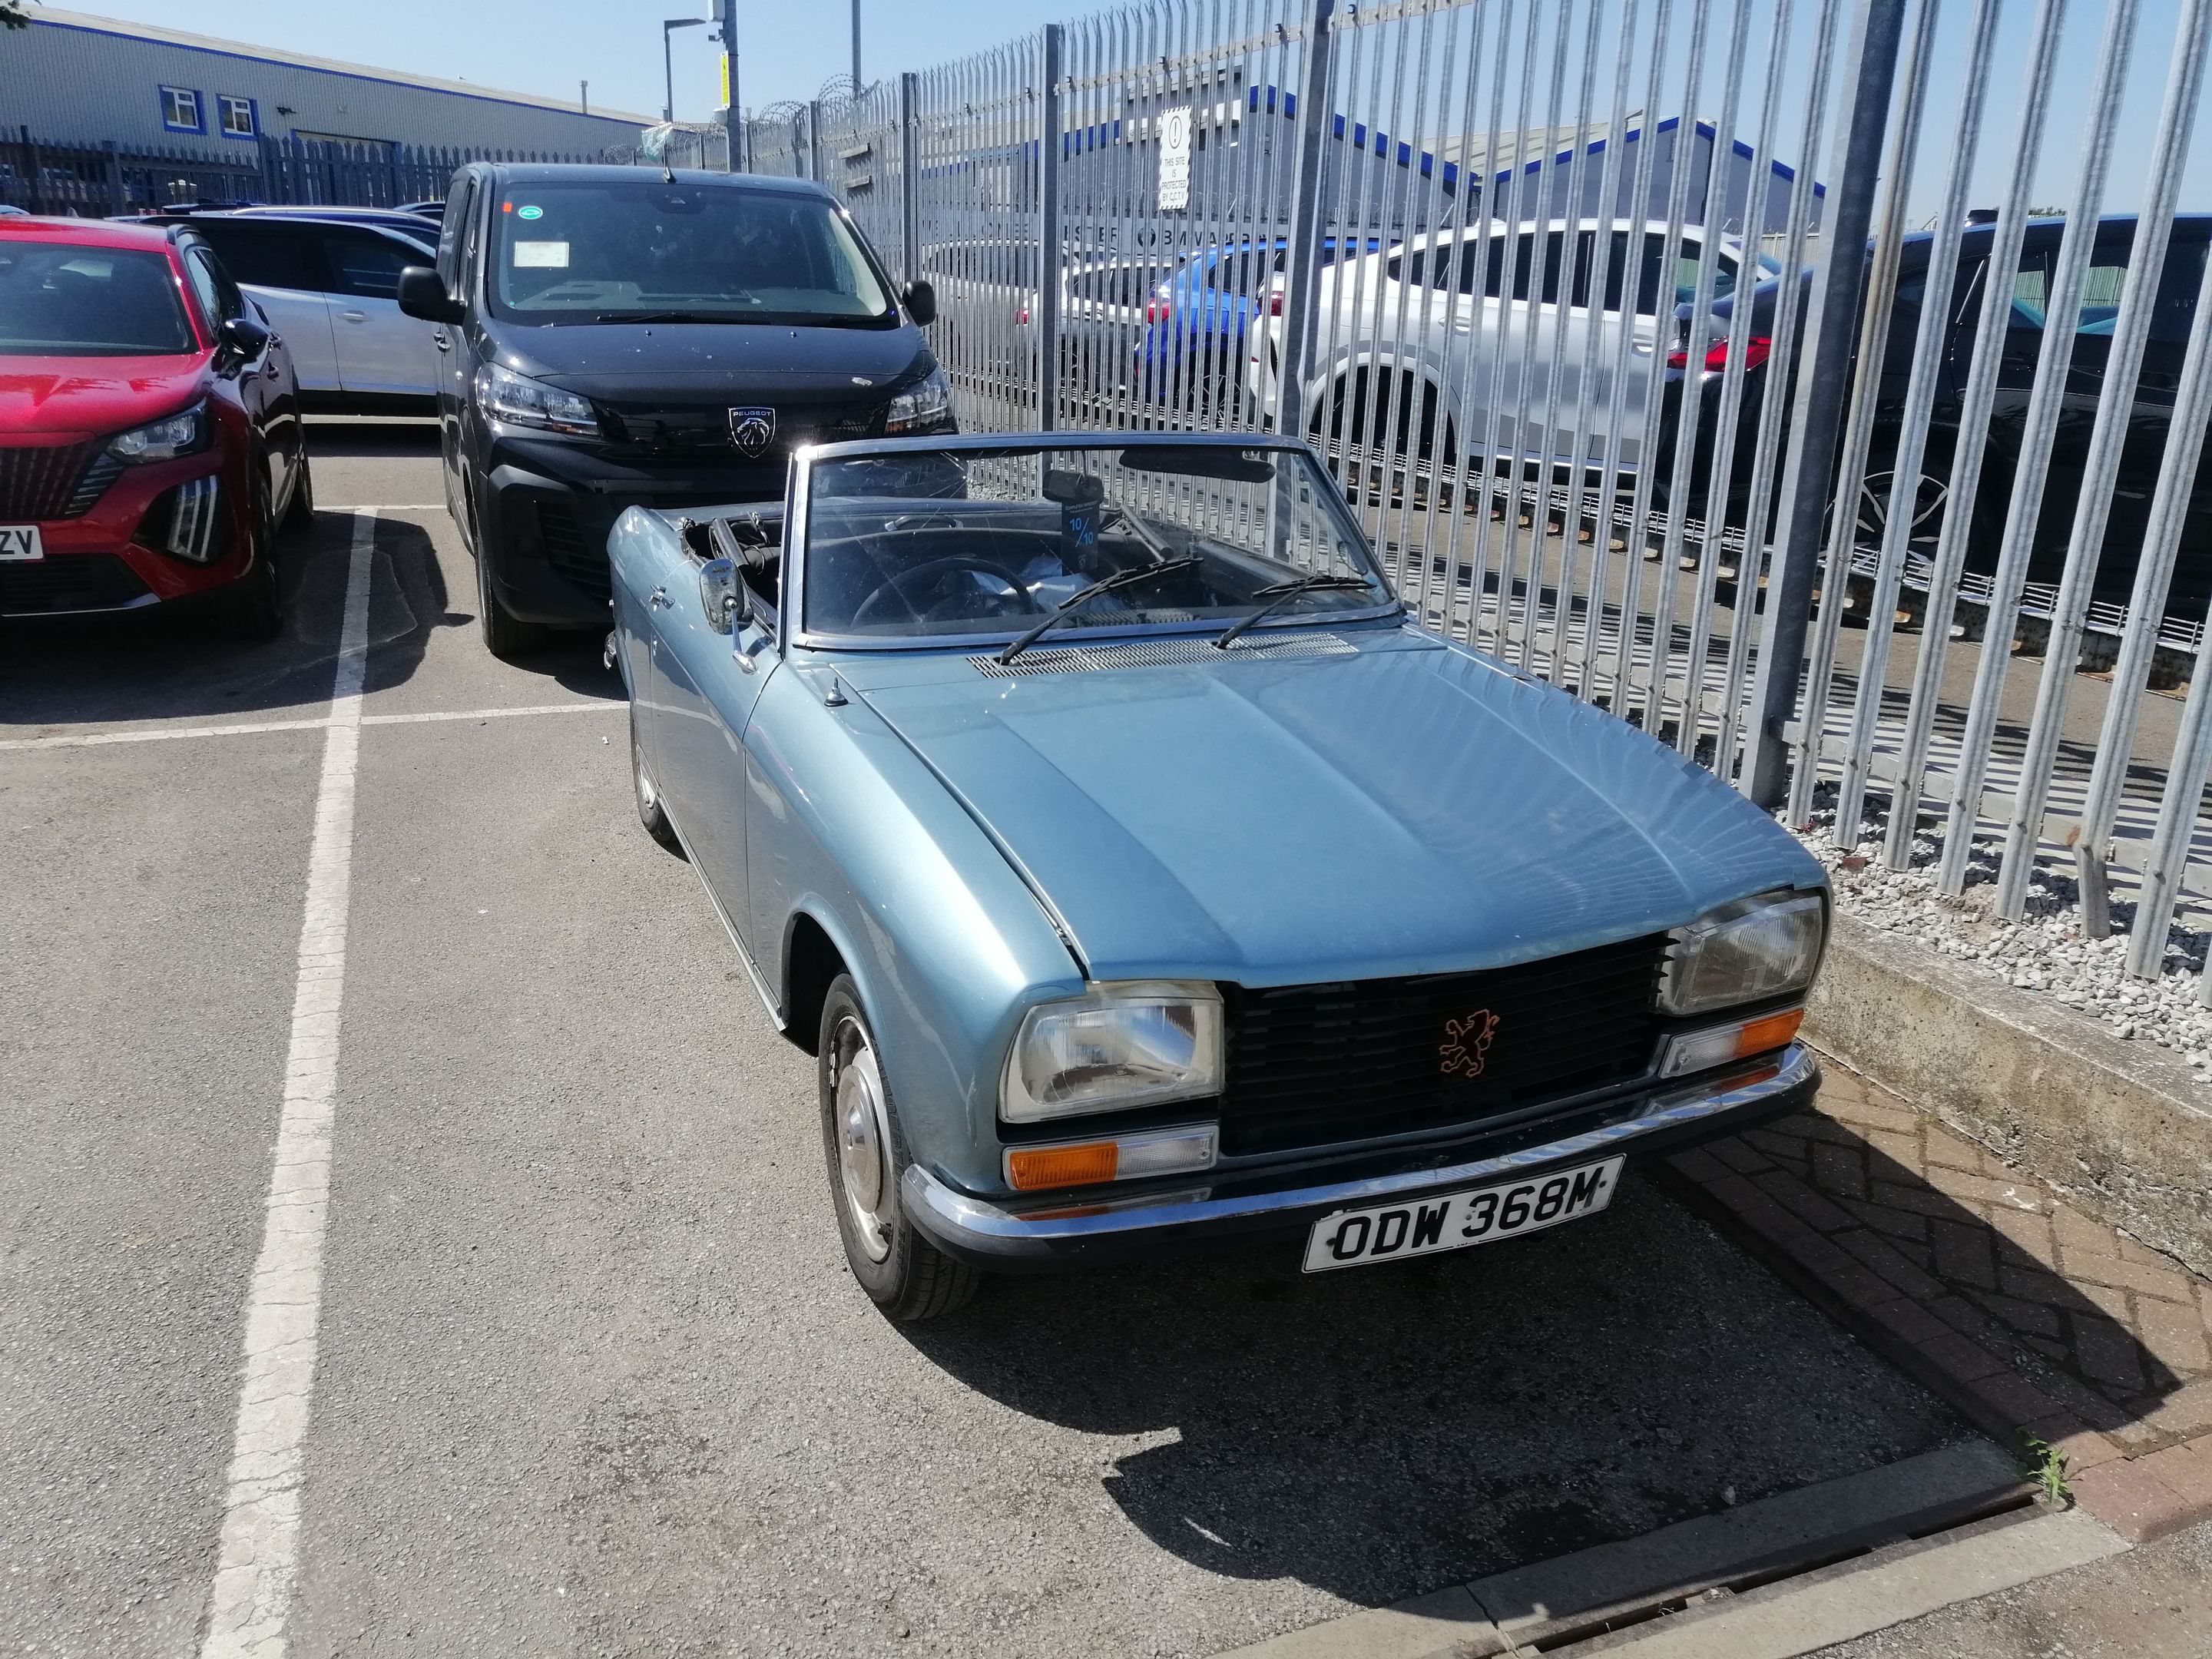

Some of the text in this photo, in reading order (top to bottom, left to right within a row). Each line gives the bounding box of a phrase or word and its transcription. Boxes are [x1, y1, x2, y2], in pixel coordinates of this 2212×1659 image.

[1164, 156, 1185, 167] THIS SITE
[1171, 168, 1177, 177] IS
[1161, 179, 1187, 190] PROTECTED
[1162, 192, 1168, 201] BY
[1331, 1166, 1605, 1261] ODW 368M
